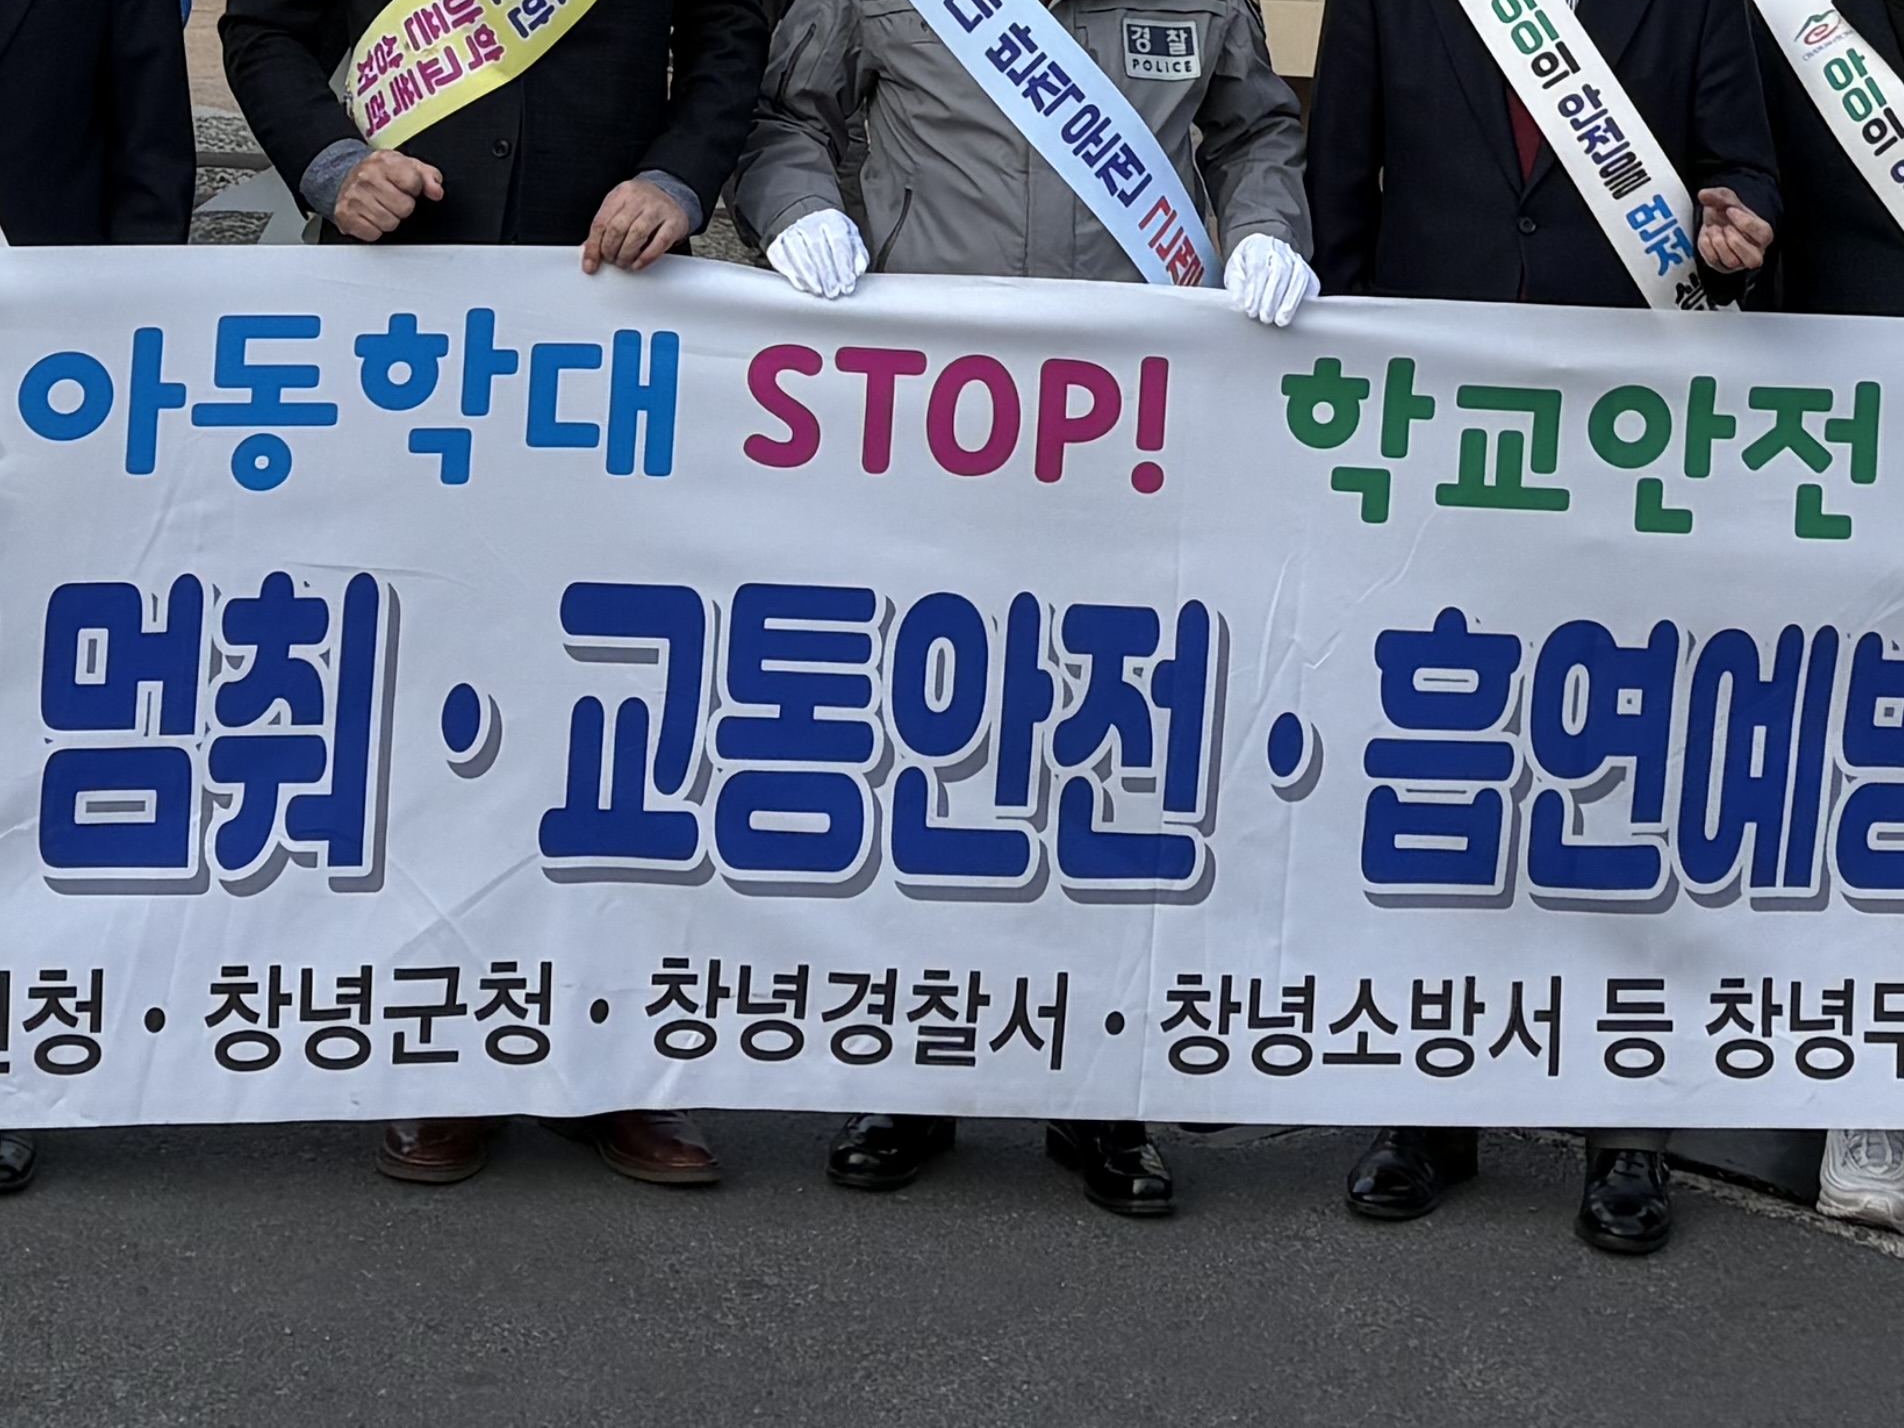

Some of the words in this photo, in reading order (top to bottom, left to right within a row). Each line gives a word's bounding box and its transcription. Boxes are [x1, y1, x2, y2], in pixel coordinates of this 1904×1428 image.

[365, 23, 506, 138] 학교폭력
[985, 21, 1154, 208] 반칙운전
[1131, 59, 1193, 74] POLICE
[1557, 83, 1652, 200] 안전을
[1625, 194, 1696, 276] 먼저
[16, 307, 680, 491] 아동학대
[742, 342, 1170, 495] STOP!
[1280, 356, 1882, 540] 학교안전
[38, 570, 382, 874] 멈춰
[539, 581, 1212, 882] 교통안전
[203, 959, 556, 1074] 창녕군청
[642, 957, 1071, 1074] 창녕경찰서
[1158, 971, 1563, 1083] 창녕소방서
[1596, 976, 1674, 1081] 등
